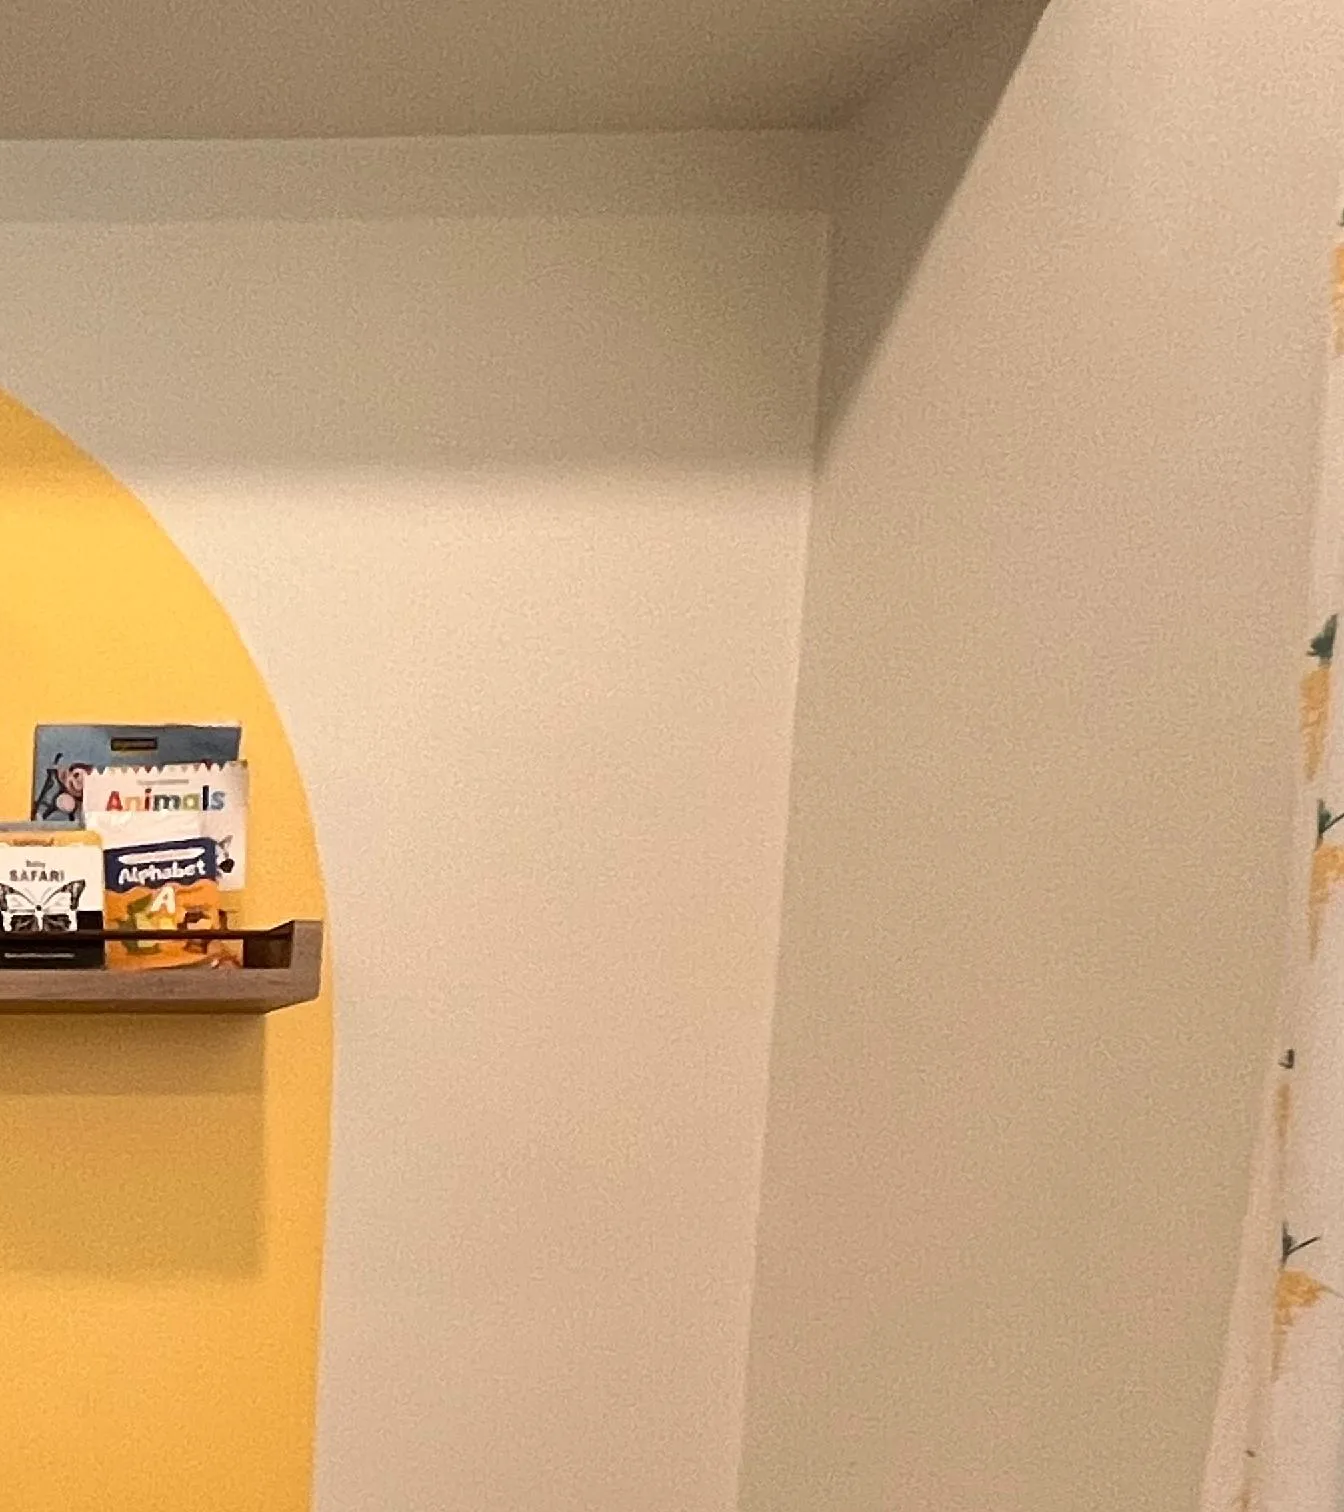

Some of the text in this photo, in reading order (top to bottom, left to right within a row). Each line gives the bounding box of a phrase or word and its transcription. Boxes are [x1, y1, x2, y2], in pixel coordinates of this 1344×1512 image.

[106, 786, 225, 811] Animals
[9, 869, 65, 882] SAFARI
[118, 860, 205, 884] Alphabet
